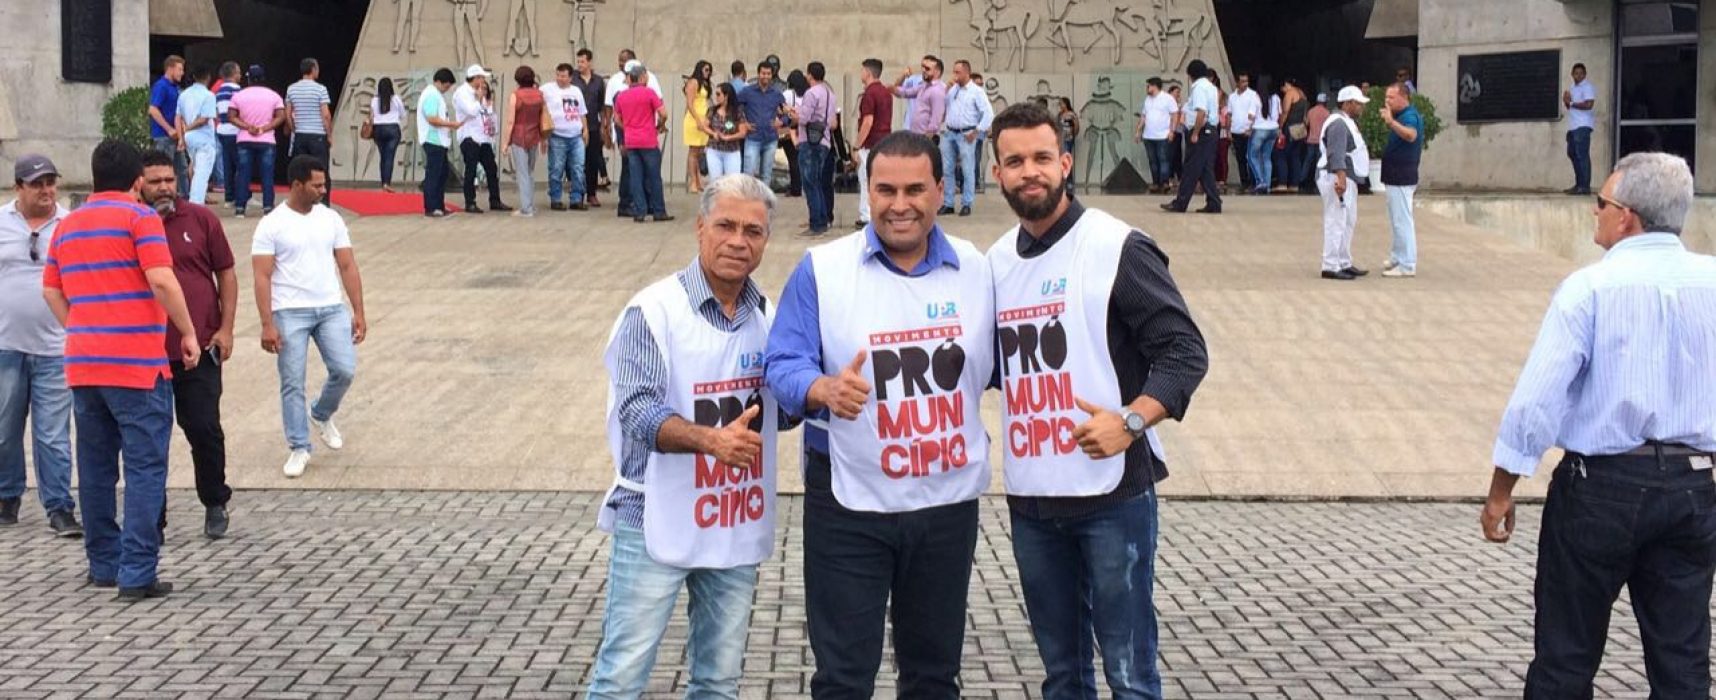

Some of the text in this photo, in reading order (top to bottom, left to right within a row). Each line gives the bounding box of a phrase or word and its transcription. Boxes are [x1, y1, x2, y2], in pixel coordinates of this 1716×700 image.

[999, 303, 1064, 321] MOVIMENTO
[871, 327, 961, 344] MOVIMENTO
[999, 315, 1067, 376] PRÓ
[872, 338, 966, 400] PRÓ
[878, 391, 964, 439] MUNI
[1005, 372, 1075, 416] MUNI
[881, 433, 967, 479] CÍPIO
[1009, 416, 1078, 457] CÍPIO
[694, 484, 764, 528] CÍPIO
